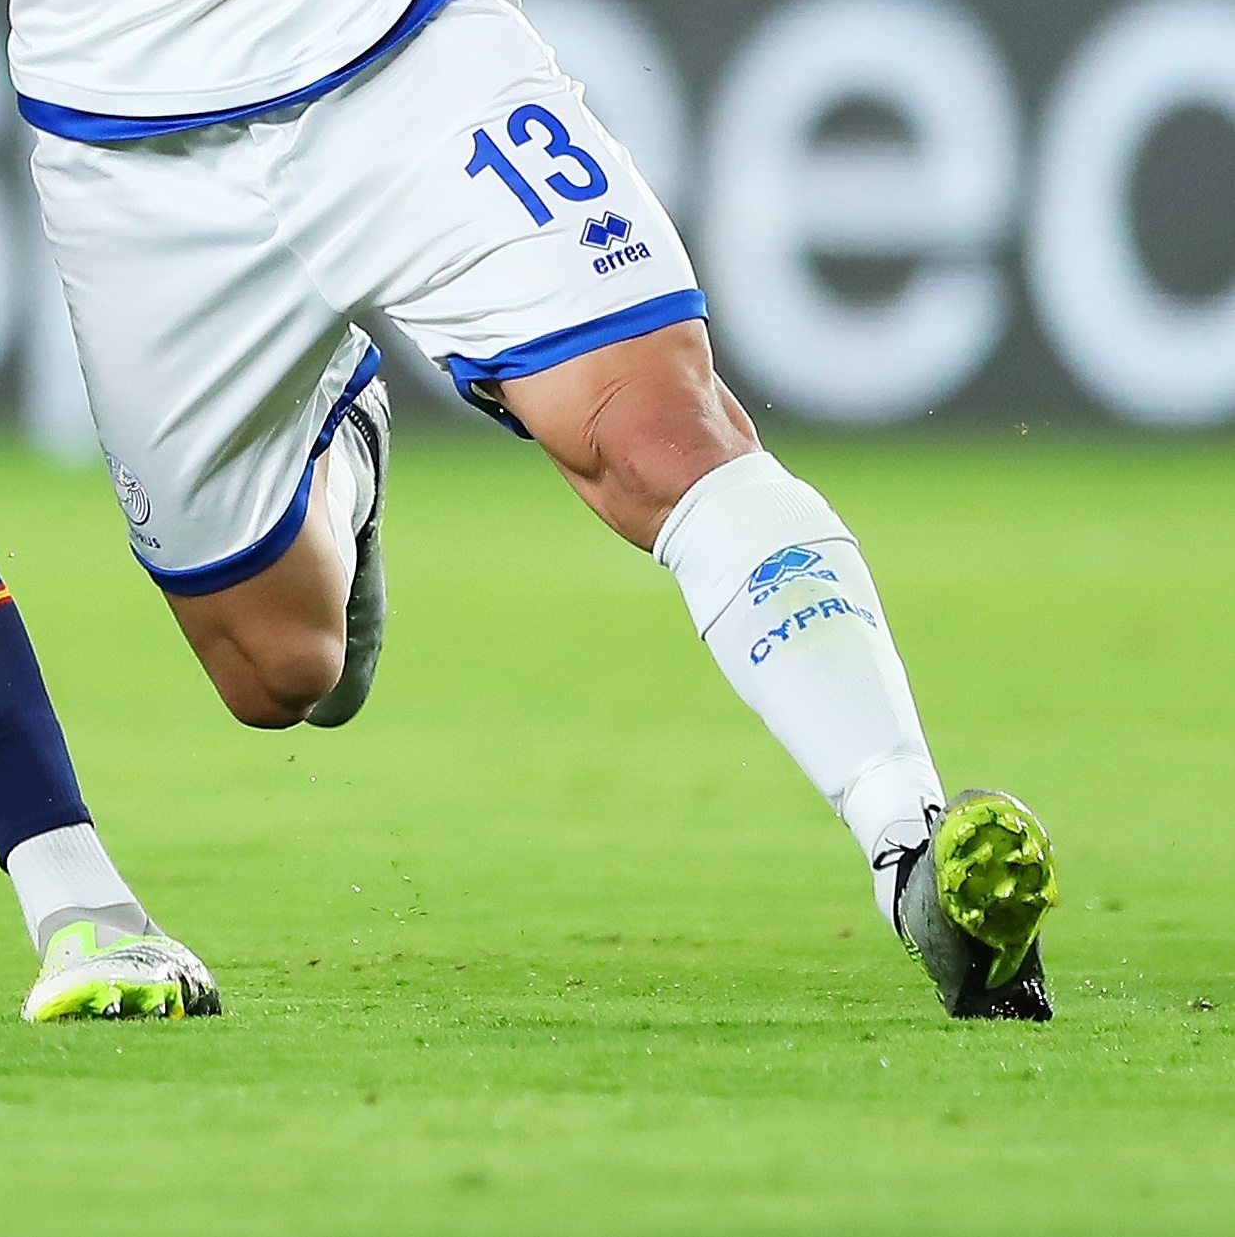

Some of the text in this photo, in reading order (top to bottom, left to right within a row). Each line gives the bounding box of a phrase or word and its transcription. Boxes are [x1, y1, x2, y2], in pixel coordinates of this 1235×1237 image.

[464, 102, 610, 228] 13
[592, 238, 654, 275] errea
[749, 597, 878, 666] CYPRUS
